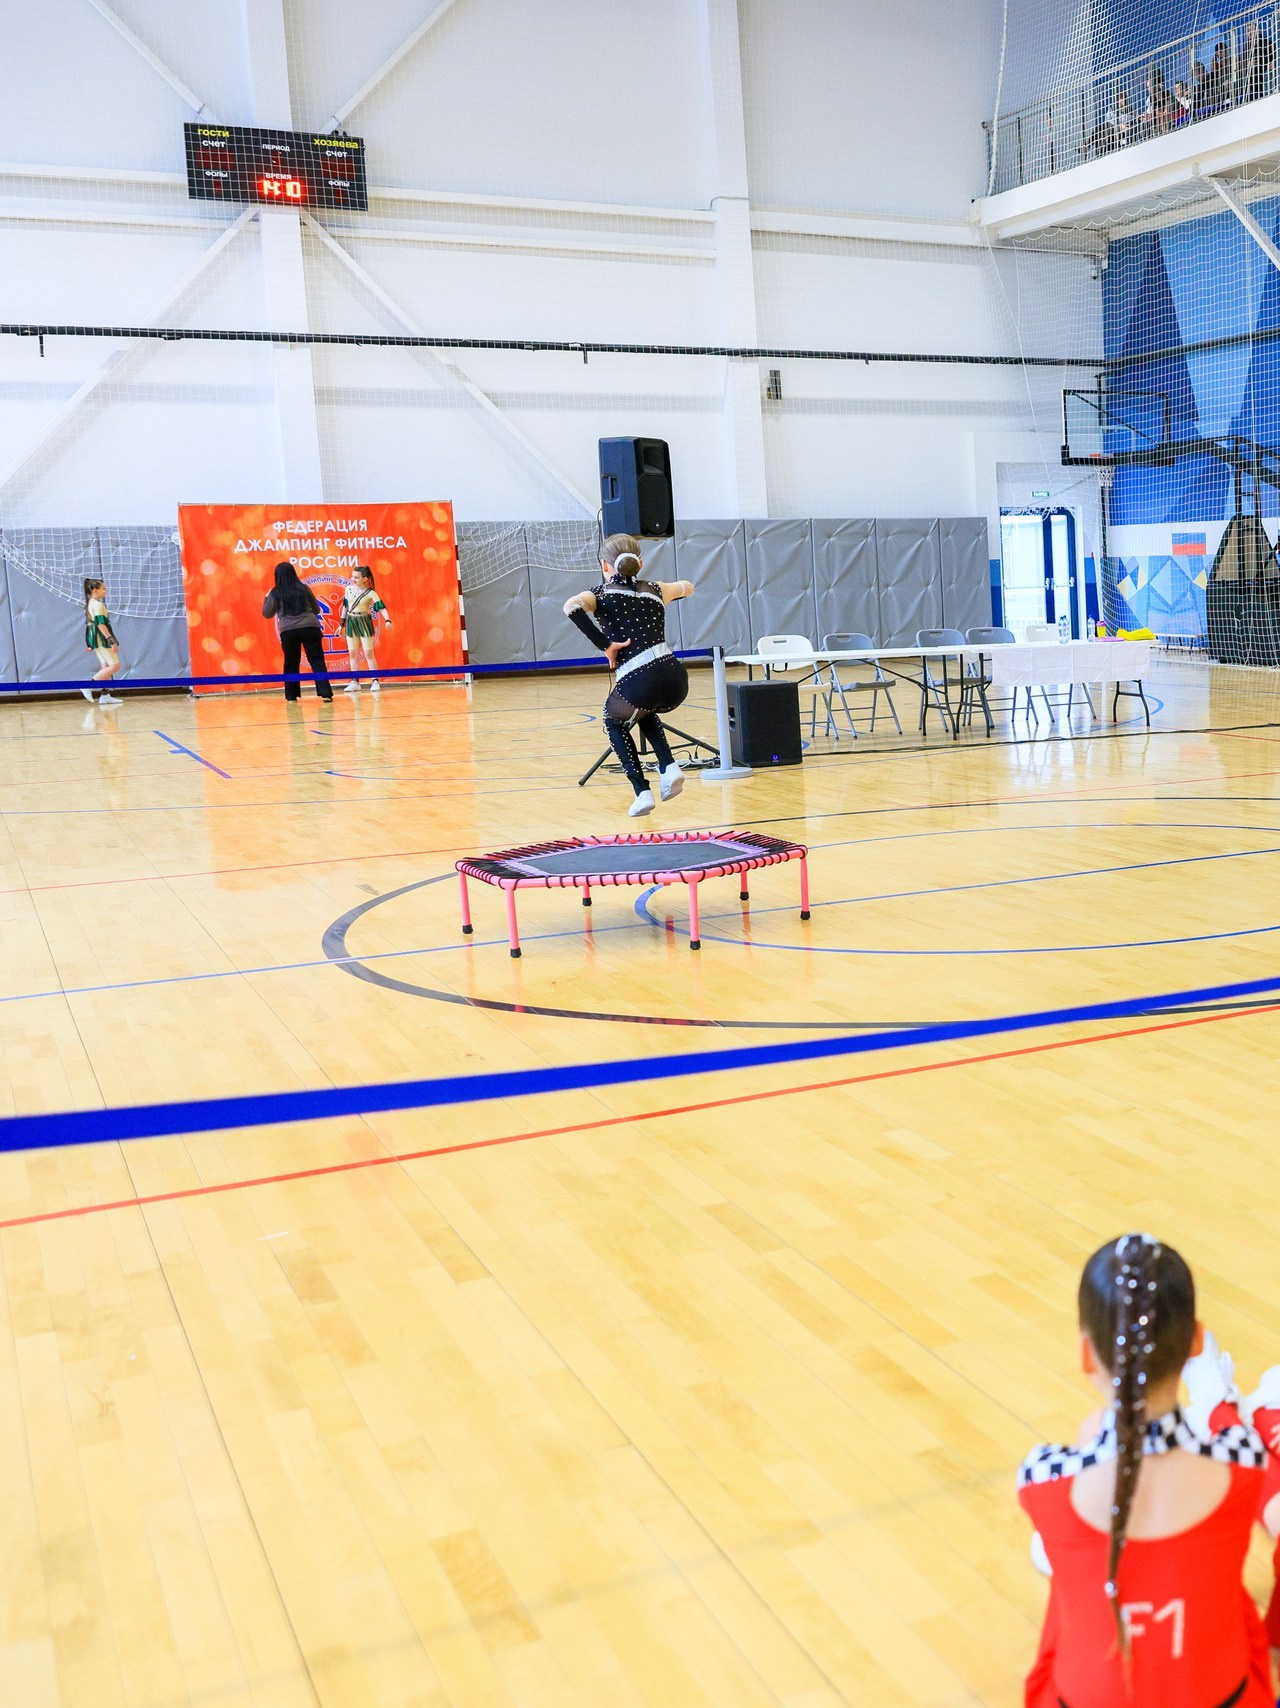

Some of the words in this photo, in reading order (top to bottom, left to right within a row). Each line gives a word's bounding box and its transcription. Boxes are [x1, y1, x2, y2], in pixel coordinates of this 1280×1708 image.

[262, 143, 291, 152] ПЕРИОД
[265, 172, 292, 180] ВРЕМЯ
[272, 519, 368, 534] ФЕДЕРАЦИЯ
[234, 537, 331, 554] ДЖАМПИНГ
[335, 536, 407, 550] ФИТНЕСА
[289, 555, 359, 569] РОССИИ
[1120, 1598, 1184, 1659] F1
